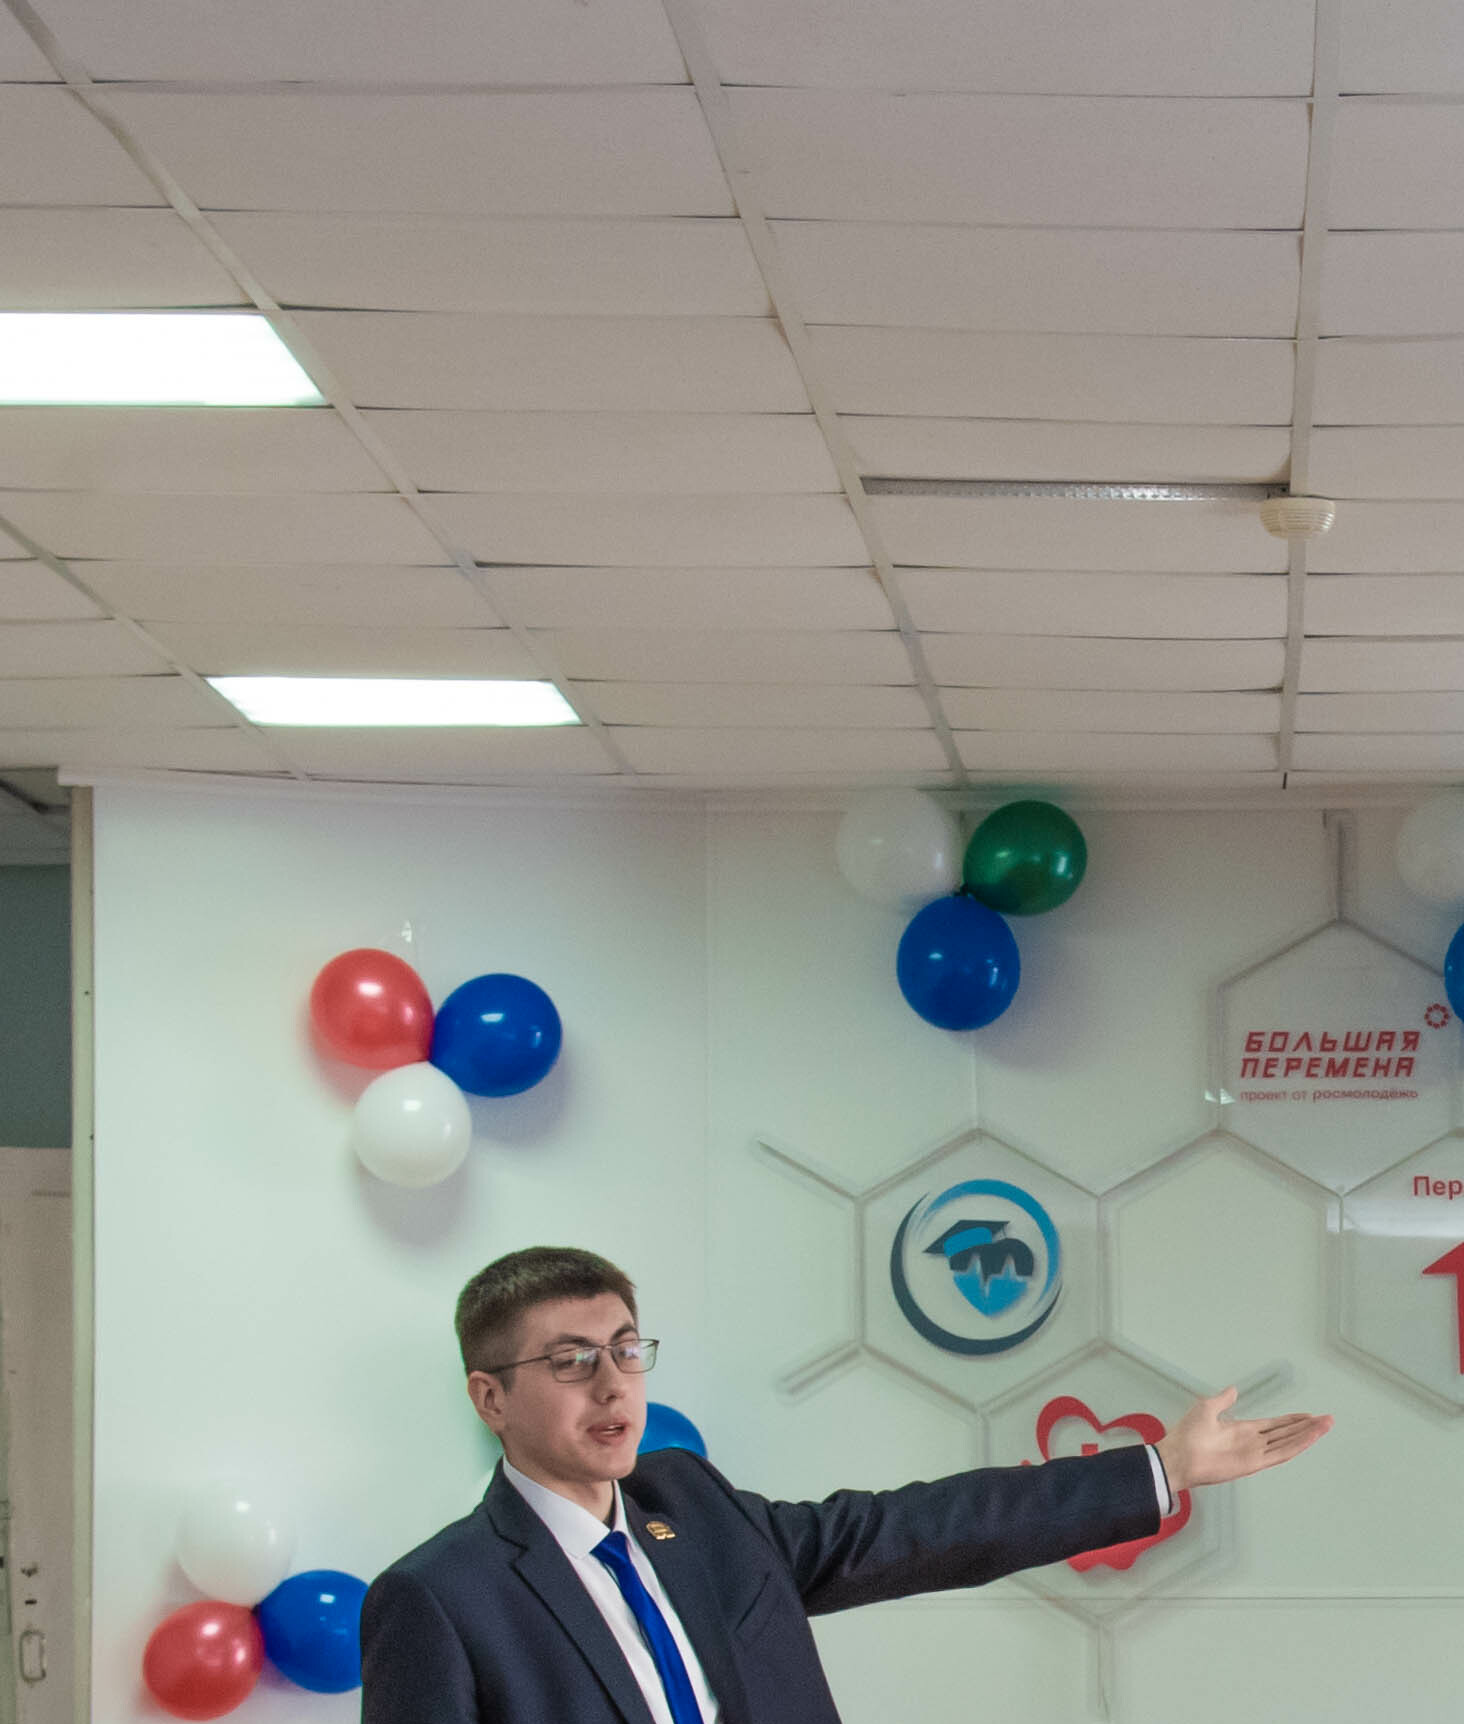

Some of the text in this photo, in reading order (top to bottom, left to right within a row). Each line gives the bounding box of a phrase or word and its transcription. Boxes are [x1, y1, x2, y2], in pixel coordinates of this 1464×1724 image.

[1244, 1030, 1421, 1053] БОЛЬШАЯ
[1240, 1056, 1416, 1079] ПЕРЕМЕНА
[1241, 1089, 1285, 1103] проект
[1291, 1090, 1307, 1101] от
